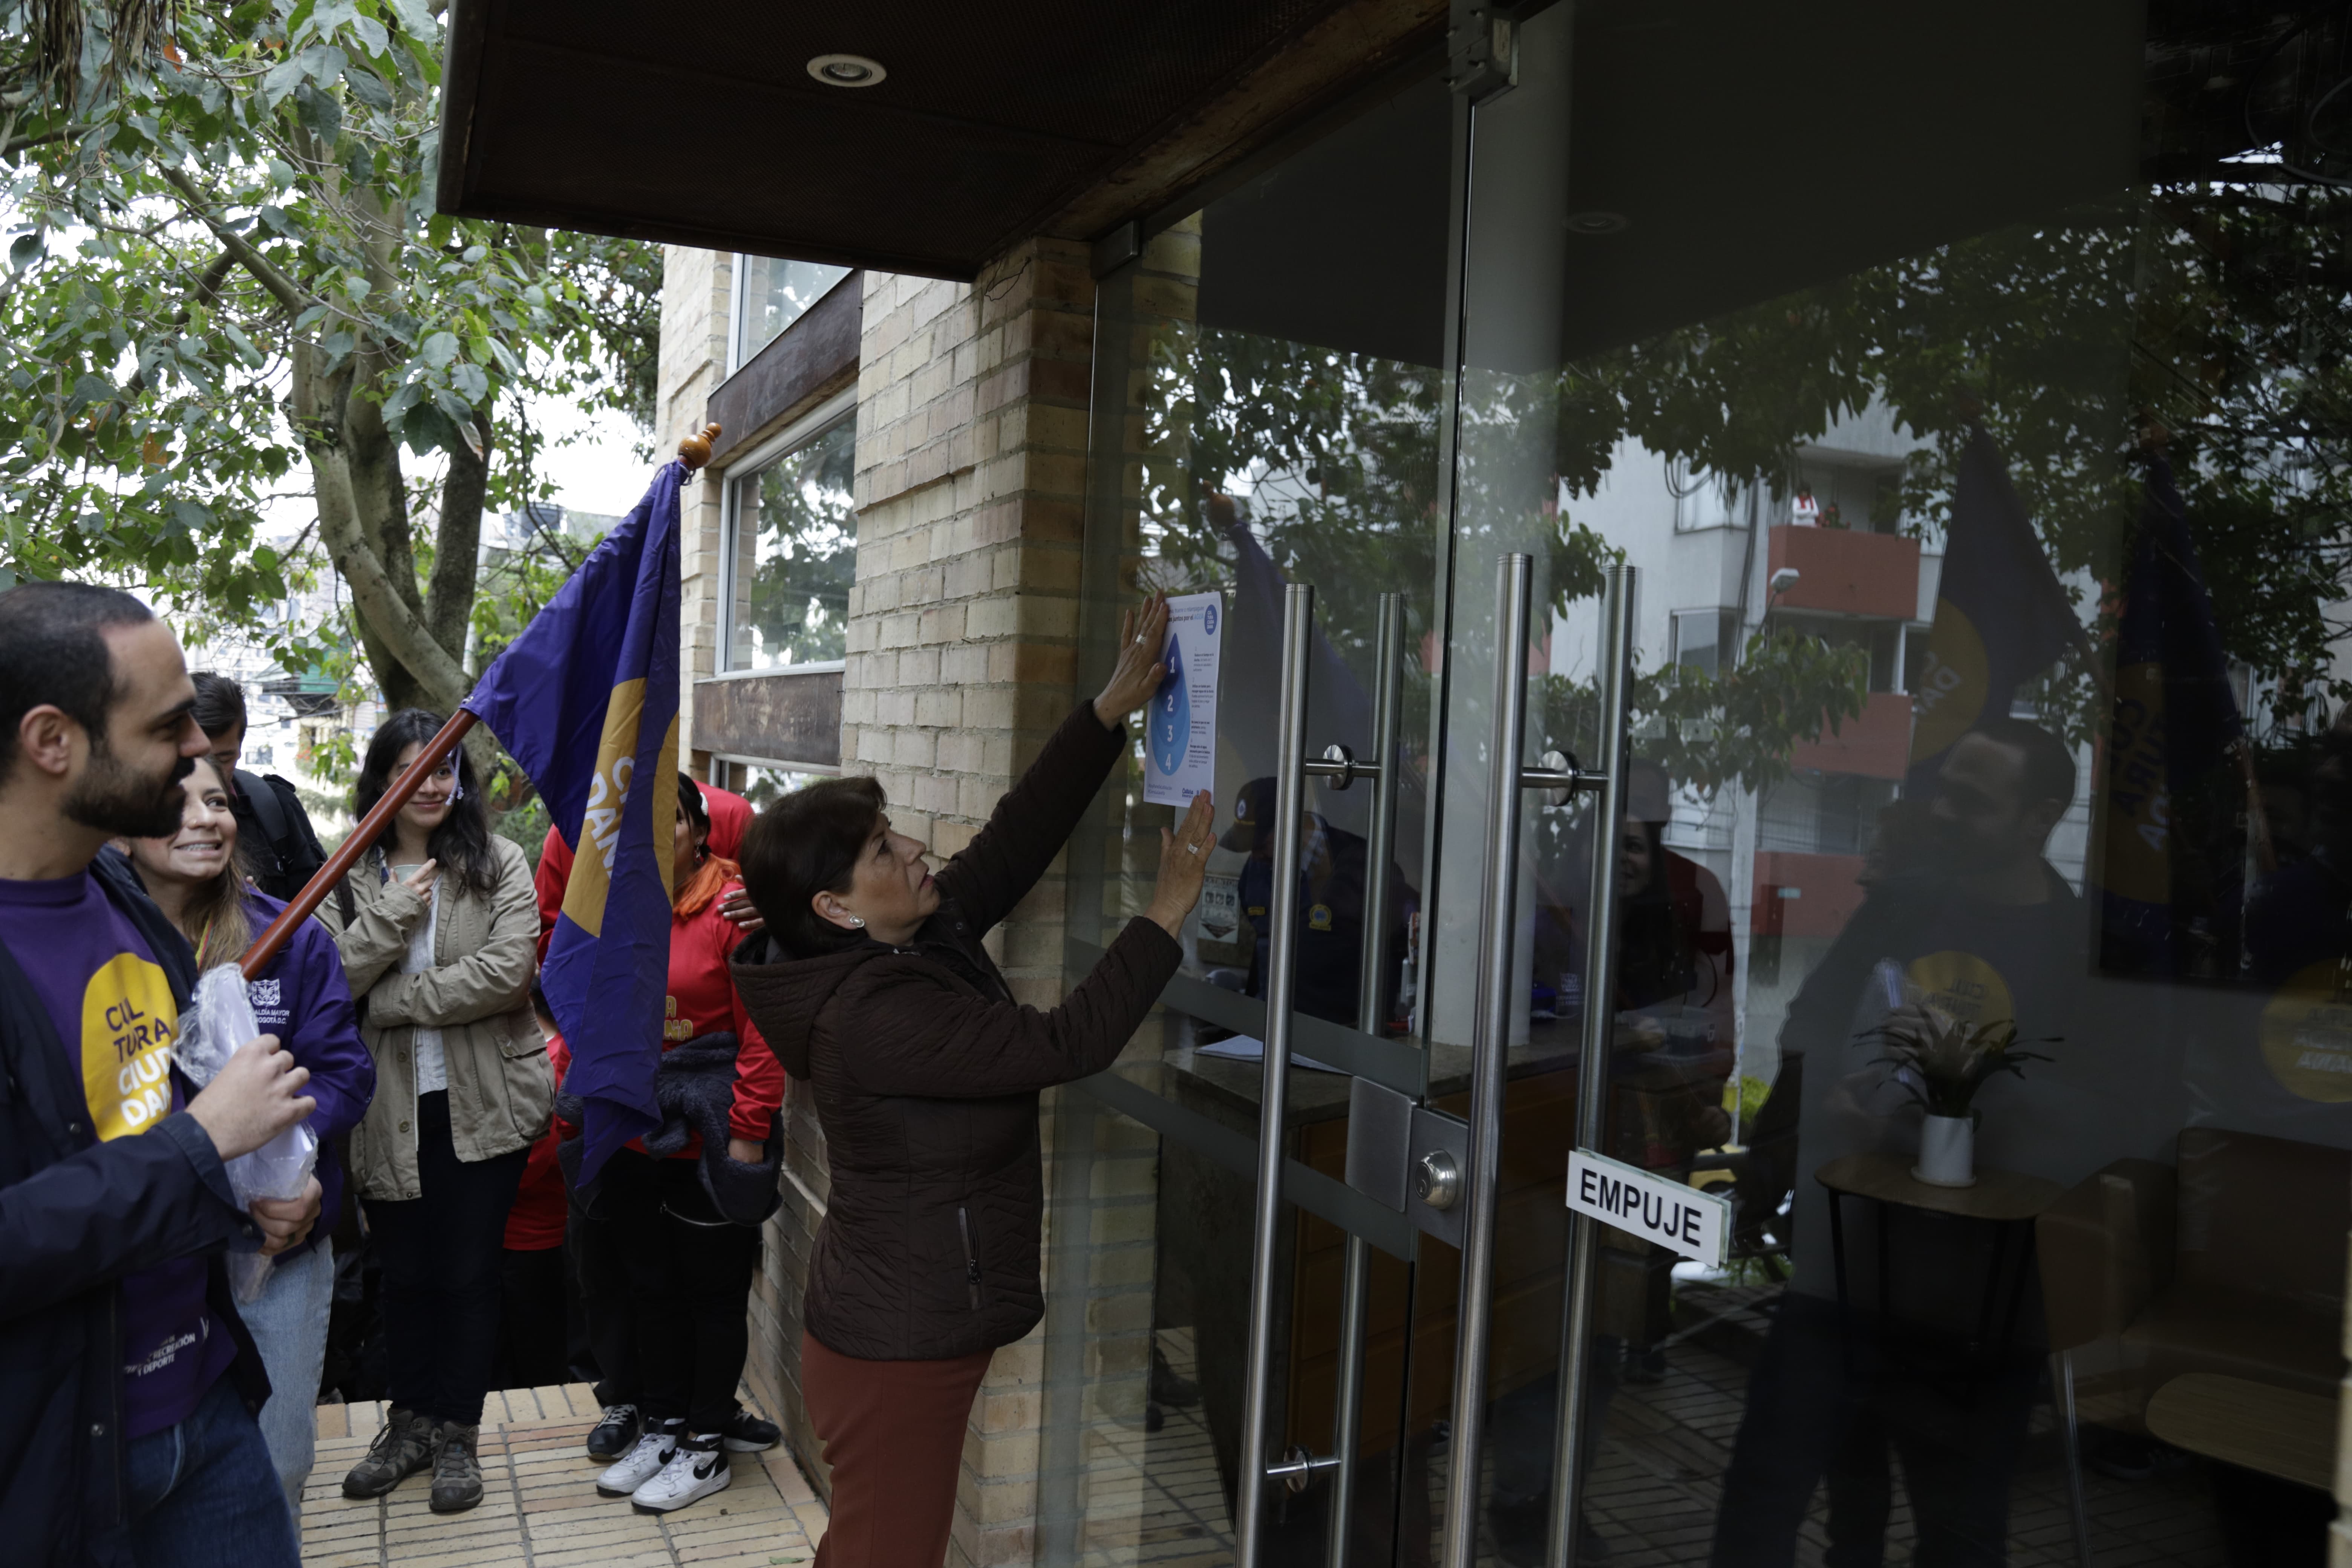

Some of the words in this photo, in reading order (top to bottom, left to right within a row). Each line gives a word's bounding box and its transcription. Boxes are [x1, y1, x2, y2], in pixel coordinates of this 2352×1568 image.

[1170, 656, 1175, 674] 1
[1167, 695, 1173, 712] 2
[1167, 725, 1173, 742] 3
[1165, 753, 1171, 770] 4
[585, 771, 620, 879] DAN
[113, 1018, 171, 1063] TURA
[1580, 1168, 1701, 1247] EMPUJE
